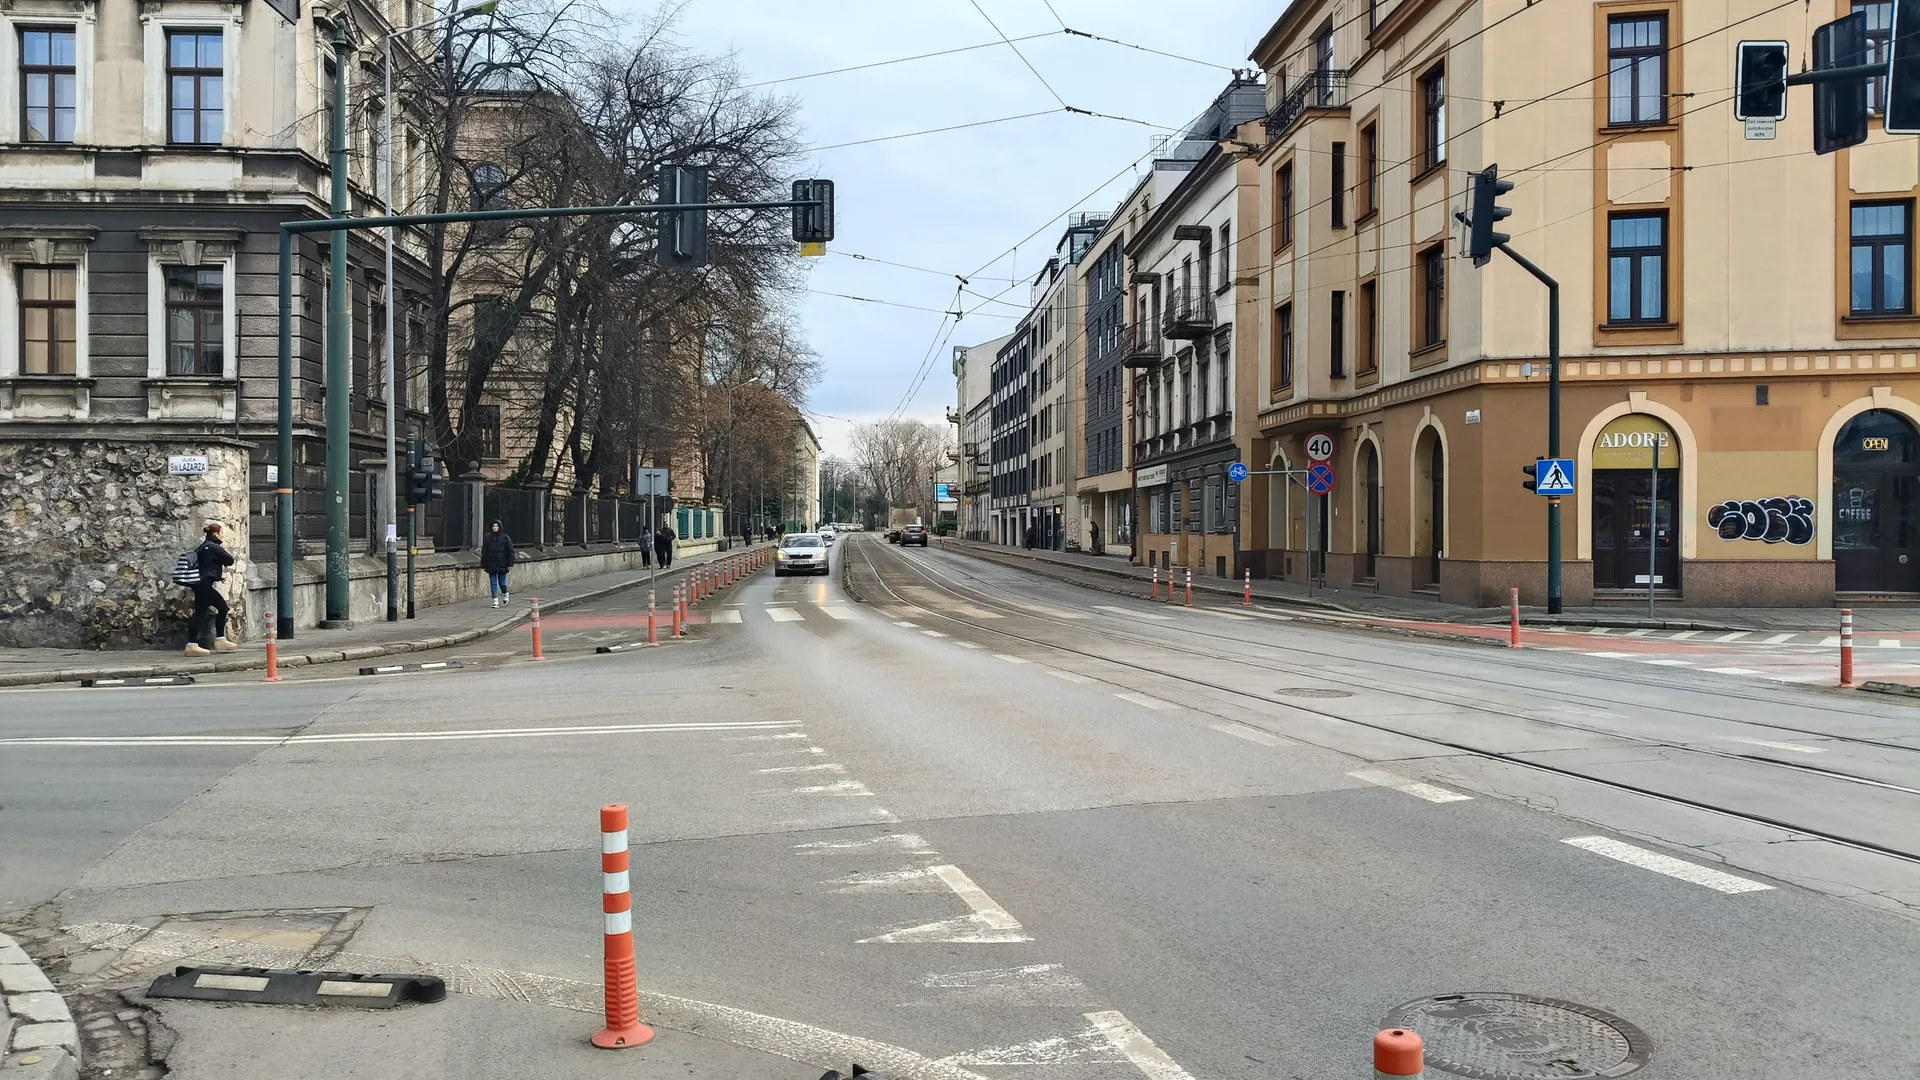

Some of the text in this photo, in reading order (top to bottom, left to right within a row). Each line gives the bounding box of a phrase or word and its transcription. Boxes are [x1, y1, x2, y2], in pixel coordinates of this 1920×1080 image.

[1599, 431, 1669, 448] ADORE
[1863, 438, 1888, 449] OPEN
[1309, 440, 1331, 455] 40
[1839, 508, 1871, 520] COFFEE
